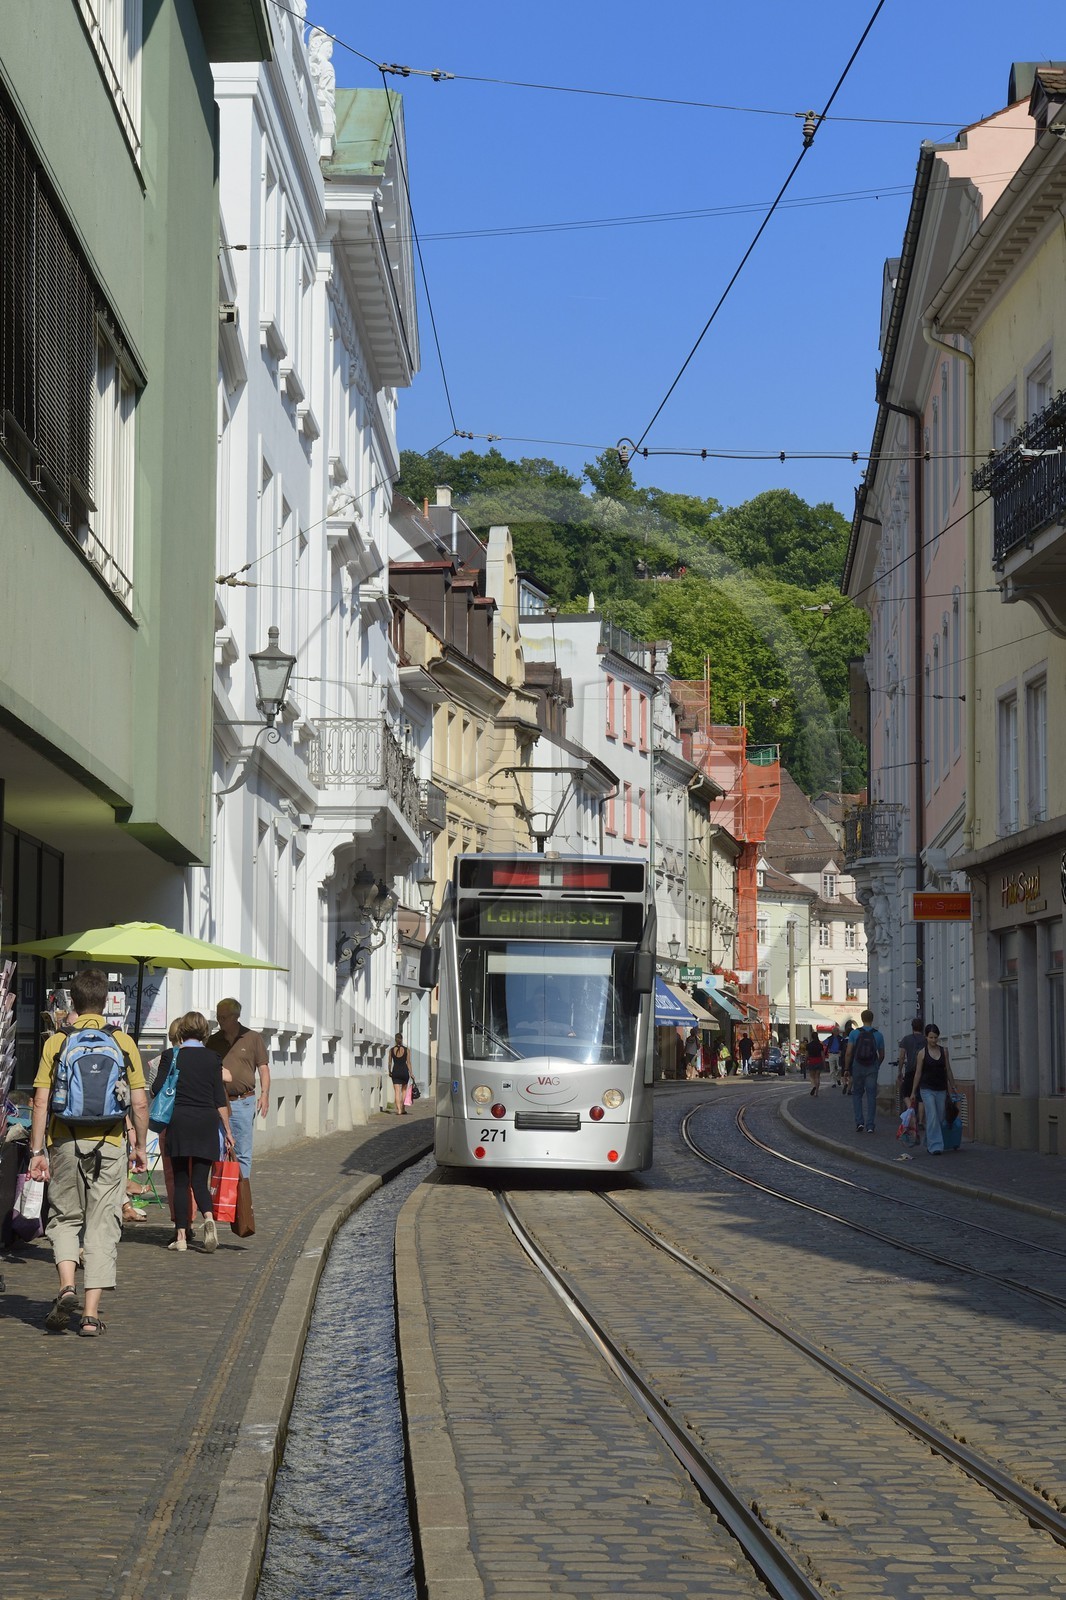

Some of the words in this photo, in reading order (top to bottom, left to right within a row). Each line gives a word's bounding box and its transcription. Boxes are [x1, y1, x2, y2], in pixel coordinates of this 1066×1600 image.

[486, 906, 614, 926] Landwasser
[538, 1076, 560, 1086] VAG
[480, 1129, 506, 1142] 271
